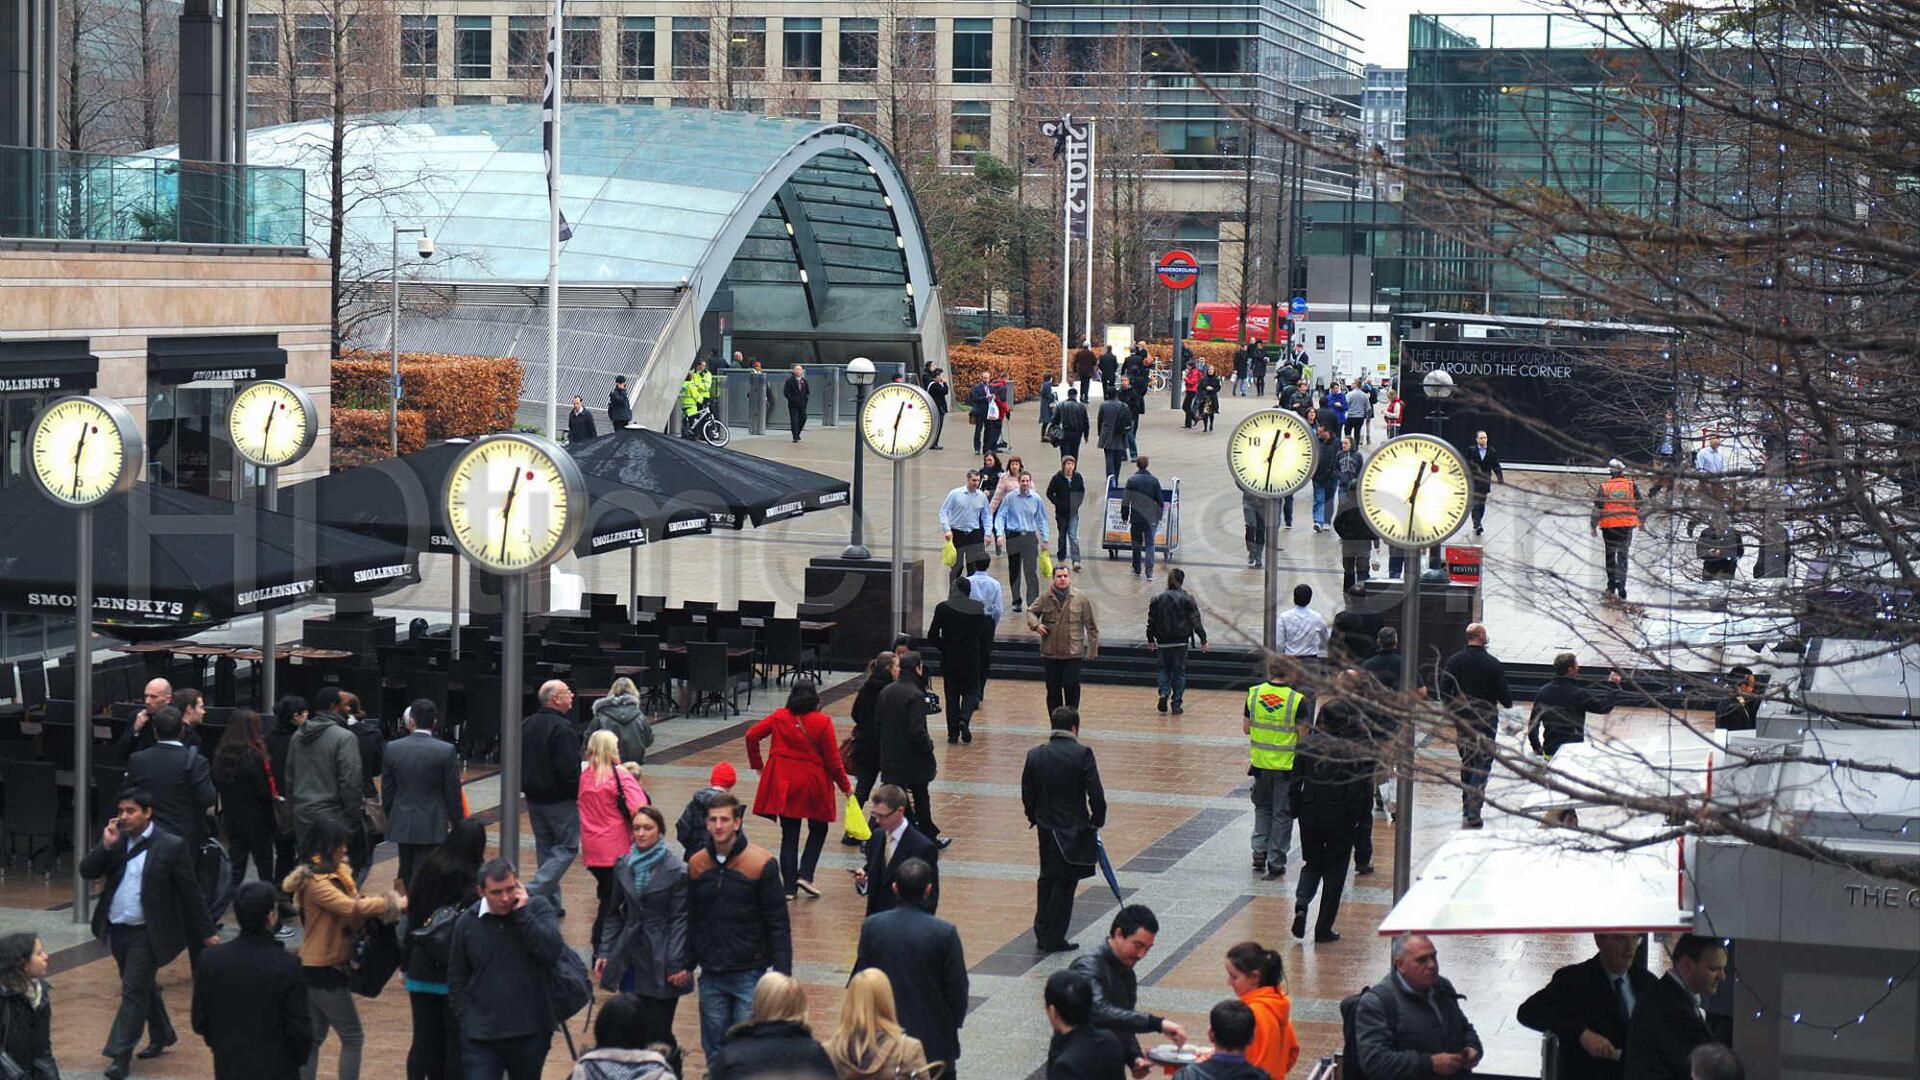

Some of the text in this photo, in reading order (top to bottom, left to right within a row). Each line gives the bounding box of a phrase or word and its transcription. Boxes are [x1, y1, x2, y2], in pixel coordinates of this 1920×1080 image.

[1157, 266, 1198, 274] UNDERGROUND
[1412, 348, 1433, 361] THE
[1435, 350, 1479, 363] FUTURE
[1482, 351, 1500, 363] OF
[1409, 361, 1572, 378] JUST AROUND THE CORNER
[27, 593, 184, 615] SMOENSKY'S
[1844, 884, 1900, 907] THE
